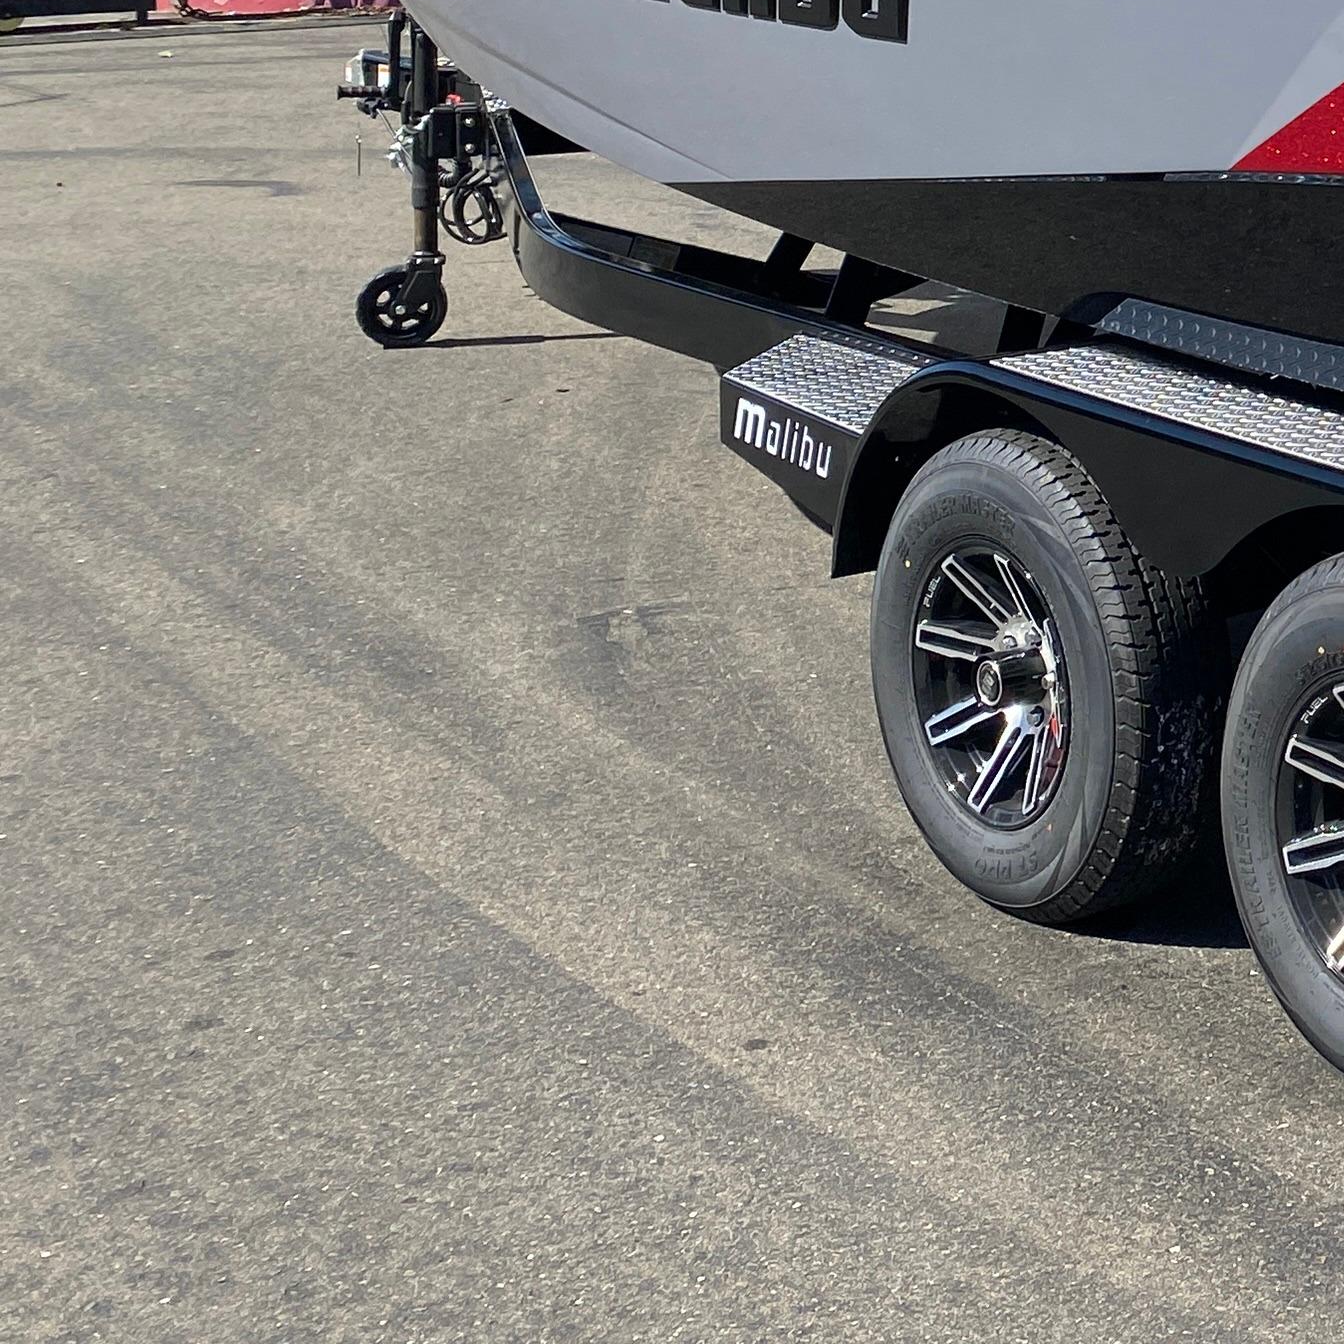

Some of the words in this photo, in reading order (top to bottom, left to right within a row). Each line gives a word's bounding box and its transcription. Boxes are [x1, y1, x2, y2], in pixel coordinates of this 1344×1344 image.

[733, 397, 832, 479] Malibu
[922, 575, 942, 608] FUEL
[1300, 695, 1329, 725] FUEL
